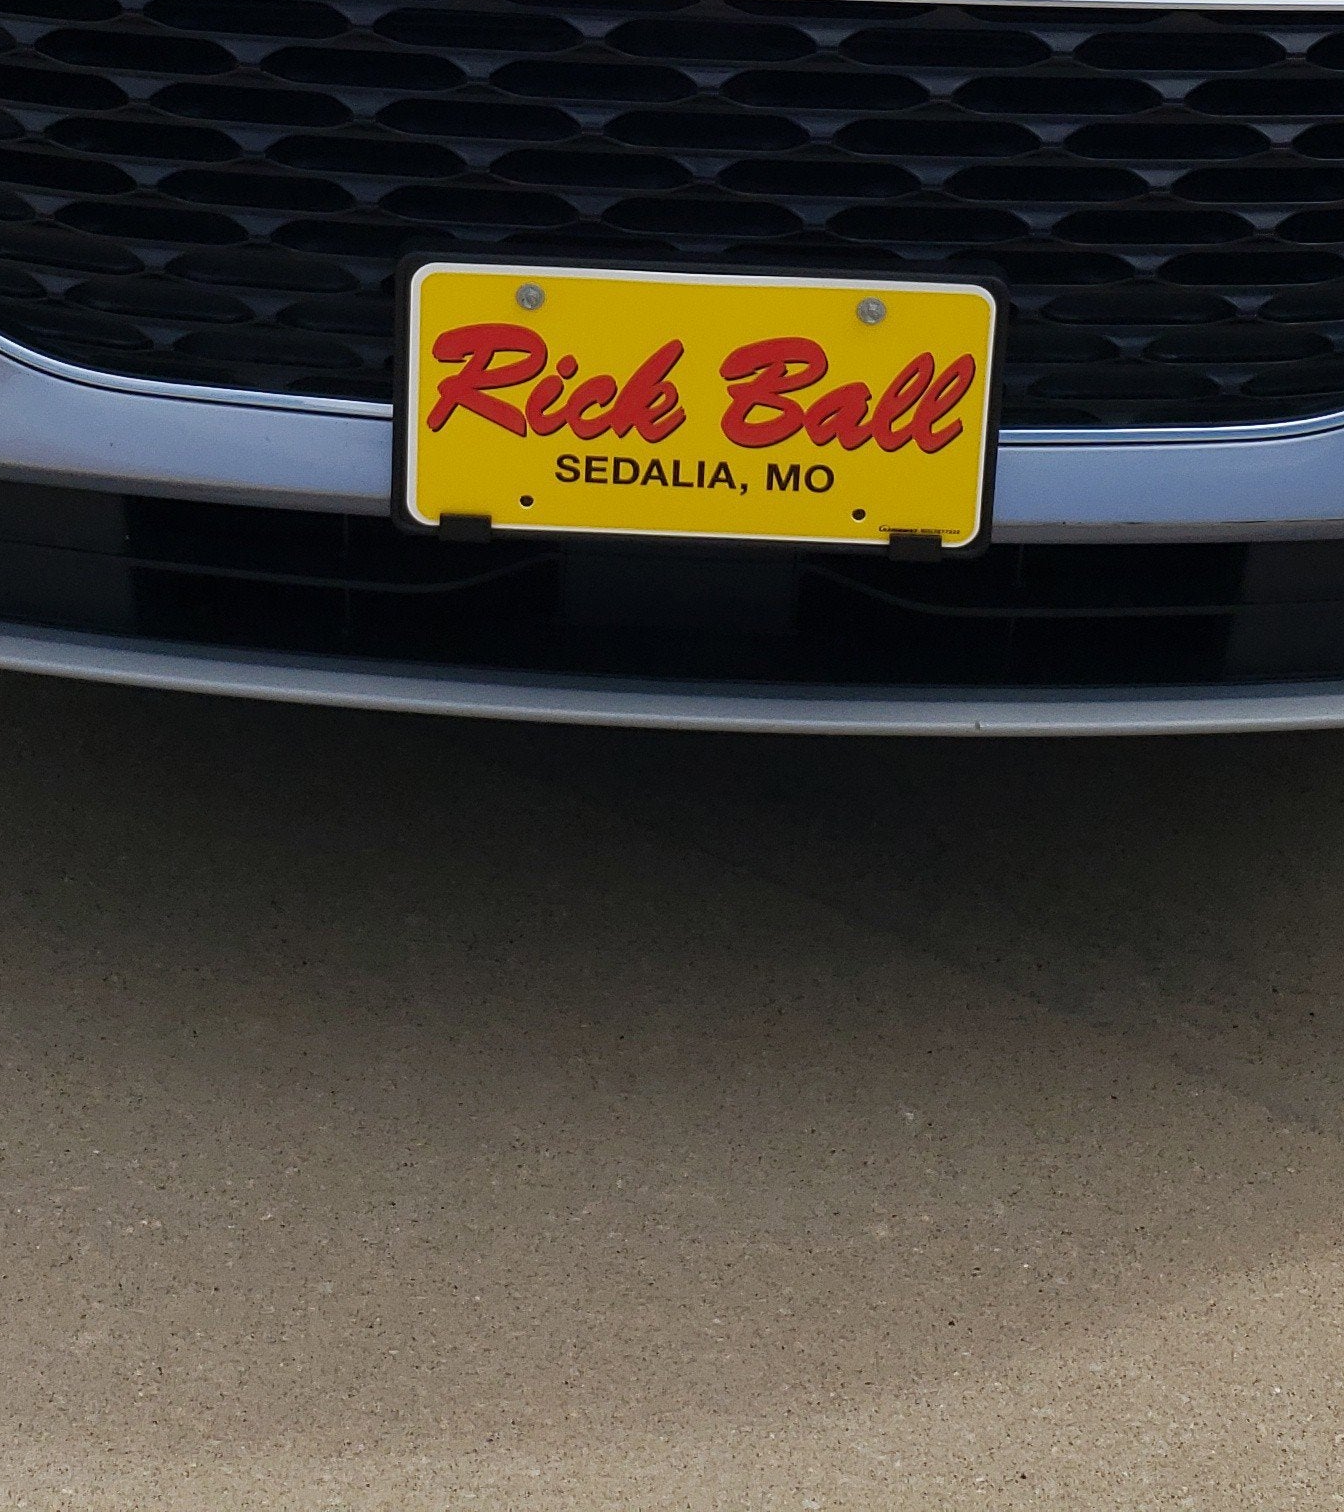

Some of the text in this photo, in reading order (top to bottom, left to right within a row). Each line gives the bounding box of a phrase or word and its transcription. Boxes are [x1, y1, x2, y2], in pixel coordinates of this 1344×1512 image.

[427, 323, 976, 454] Rick Ball
[555, 454, 836, 495] SEDALIA, MO
